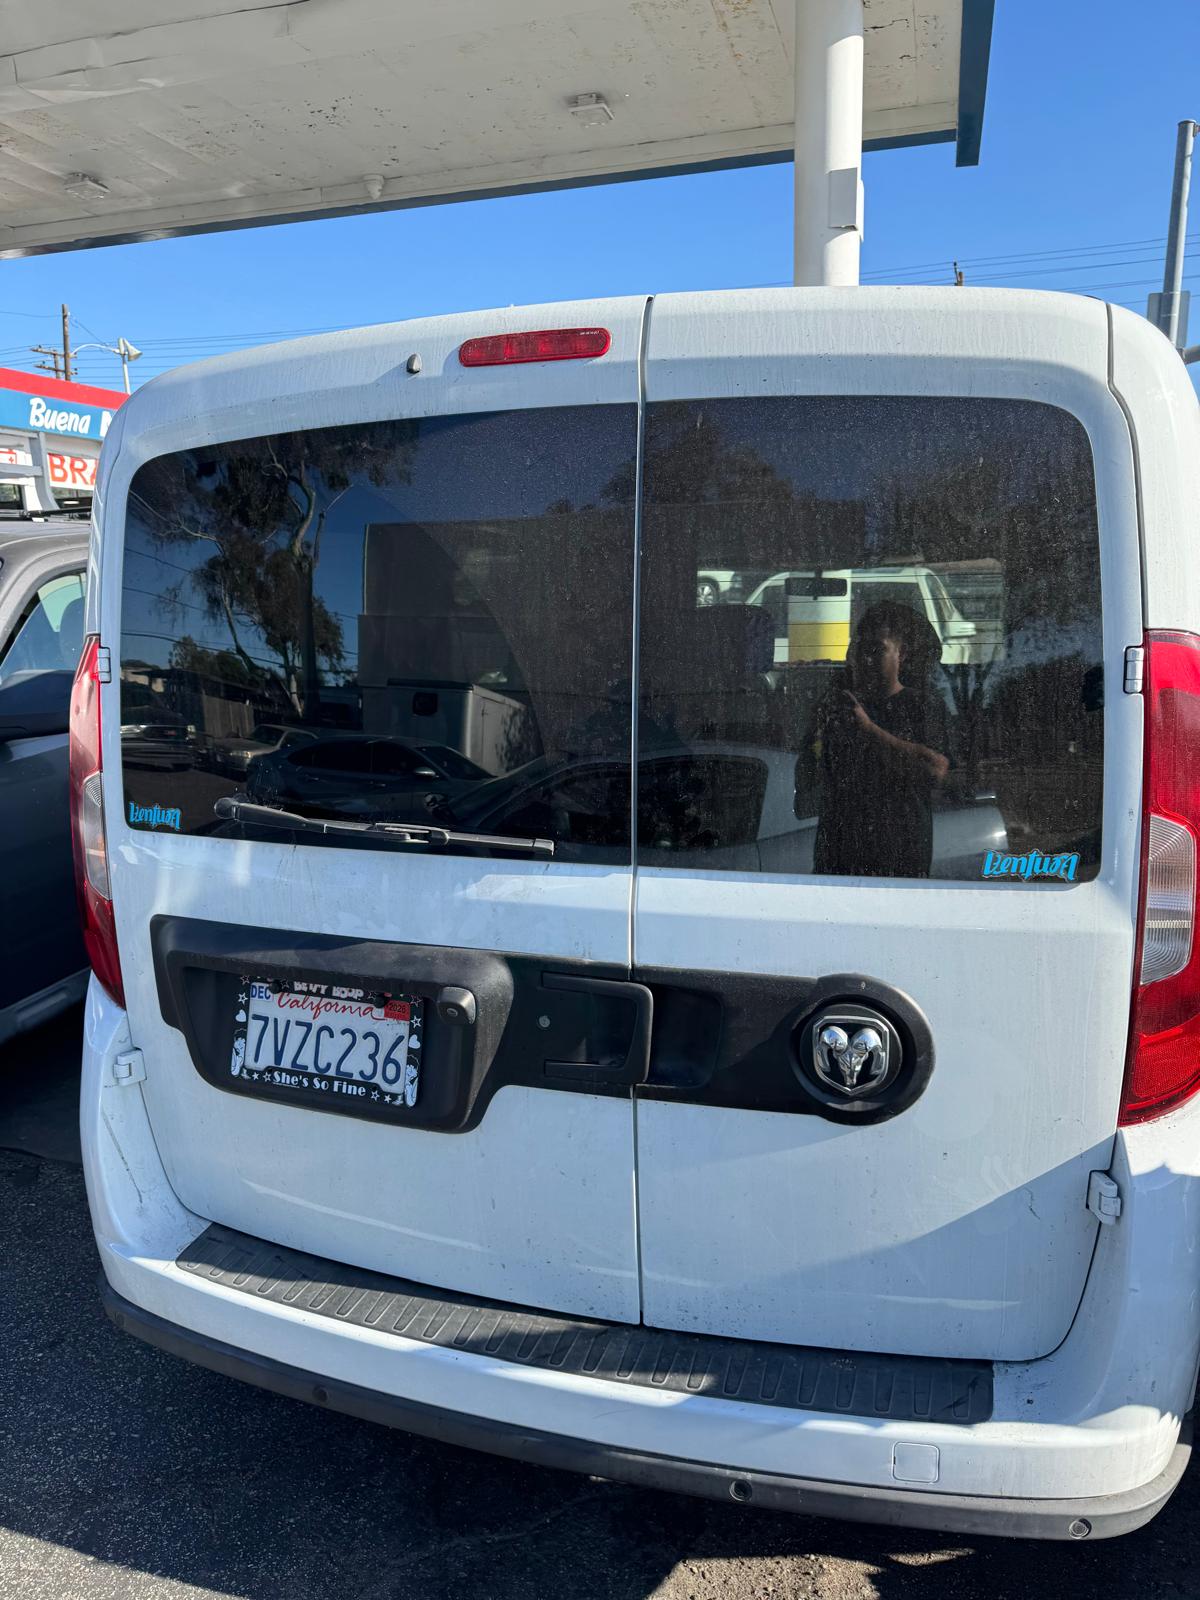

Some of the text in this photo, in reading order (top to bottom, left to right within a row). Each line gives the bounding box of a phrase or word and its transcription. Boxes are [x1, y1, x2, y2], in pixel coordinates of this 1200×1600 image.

[29, 398, 91, 434] Buena
[250, 985, 271, 1000] DEC
[277, 992, 386, 1021] California
[252, 1013, 405, 1084] 7VZC236
[273, 1070, 367, 1097] She's So Fine
